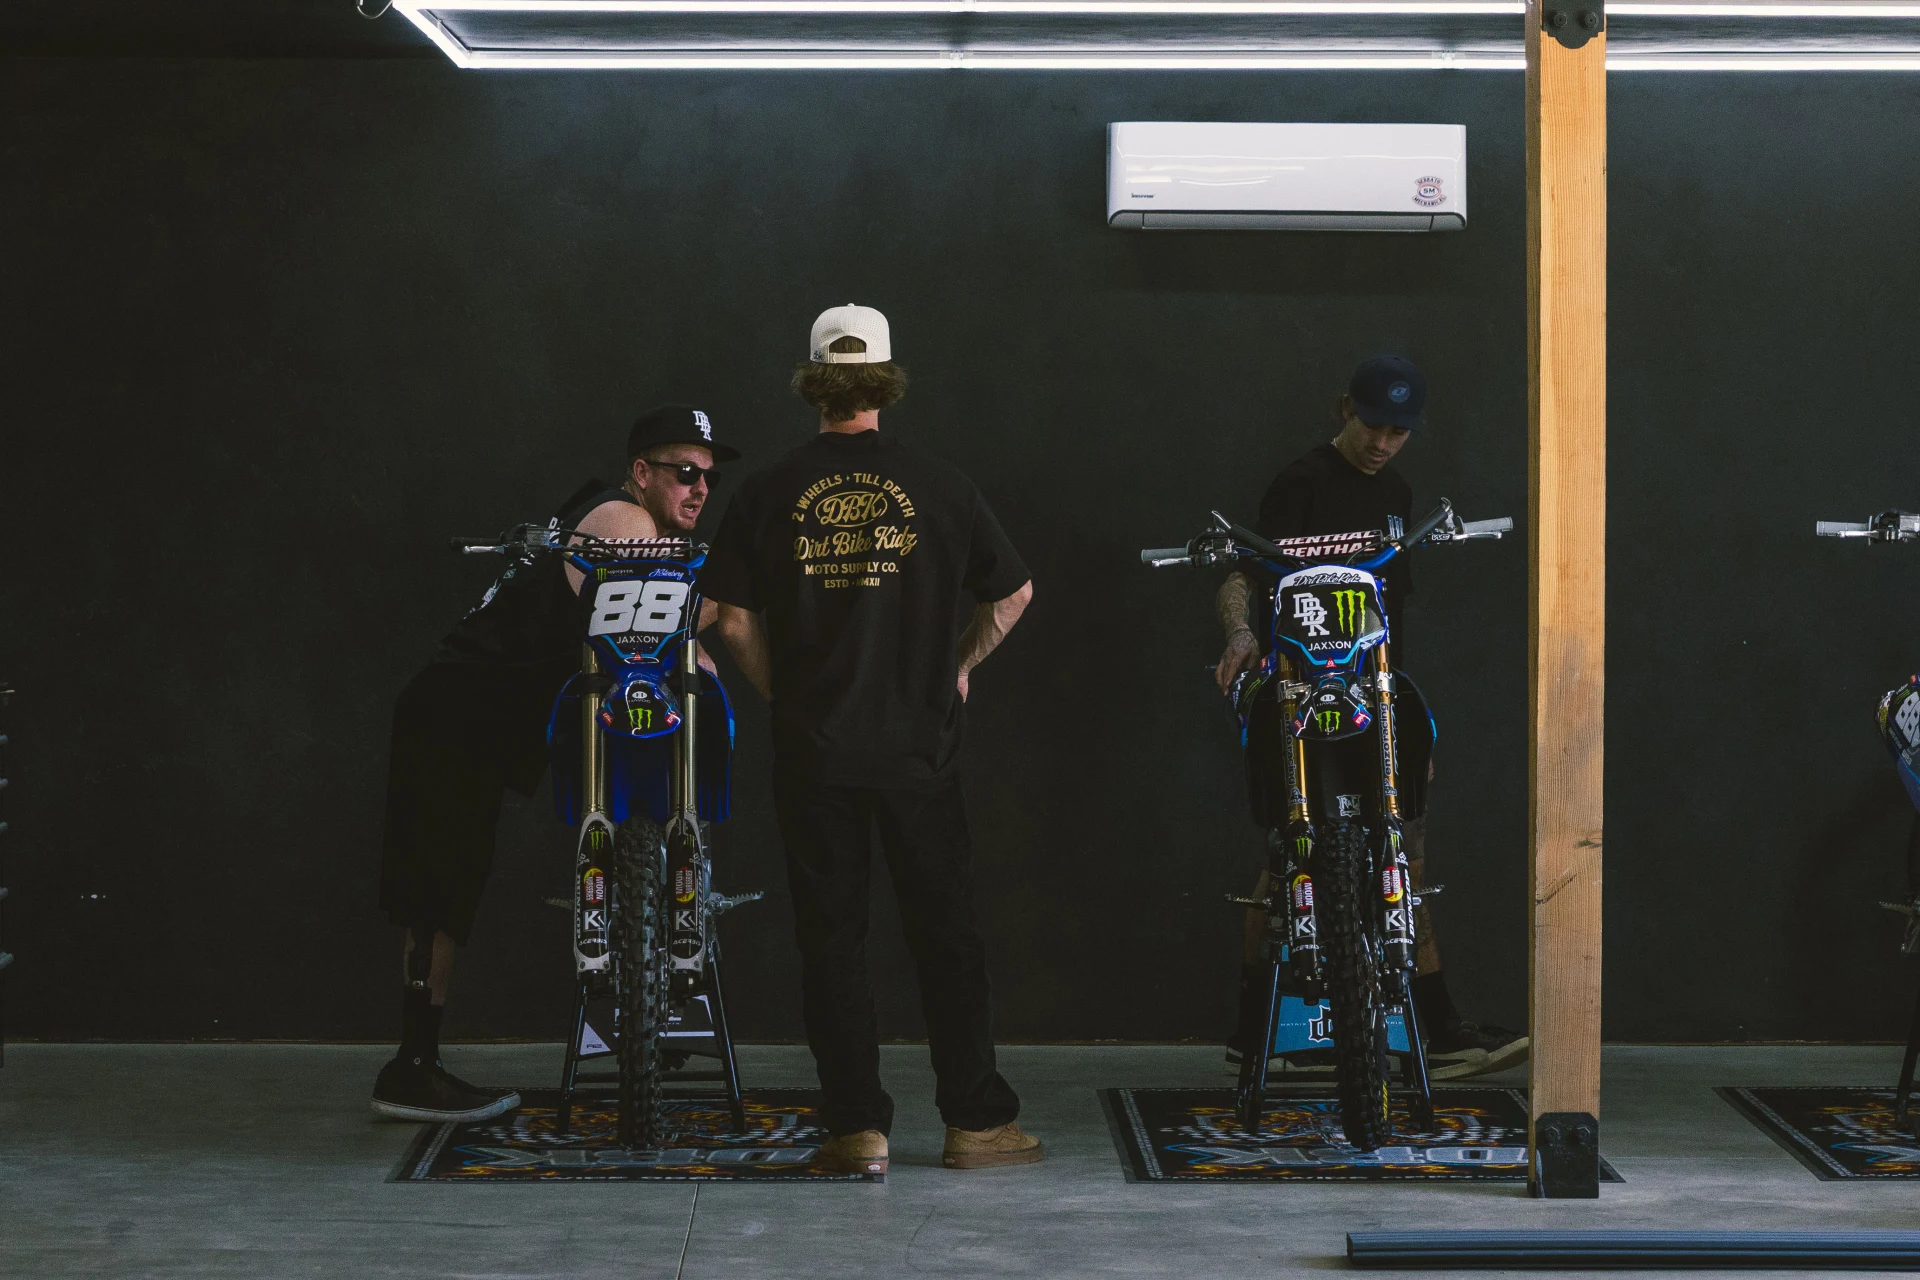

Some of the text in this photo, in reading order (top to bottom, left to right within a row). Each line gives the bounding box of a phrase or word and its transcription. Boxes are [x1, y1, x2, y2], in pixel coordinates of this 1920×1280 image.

[791, 472, 916, 523] 2 WHEELS TILL DEATH
[820, 492, 884, 525] DBK
[793, 525, 918, 561] Dirt Bike Kidz
[1278, 530, 1376, 546] RENTHAL
[1283, 541, 1376, 558] RENTHAL
[805, 561, 899, 575] MOTO SUPPLY CO.
[824, 579, 849, 589] ESTD
[588, 580, 690, 637] 88
[617, 635, 659, 644] JAXXON
[1308, 640, 1352, 651] JAXXON
[596, 876, 604, 900] MOON
[1303, 882, 1313, 906] MOON
[1382, 870, 1390, 894] MOON
